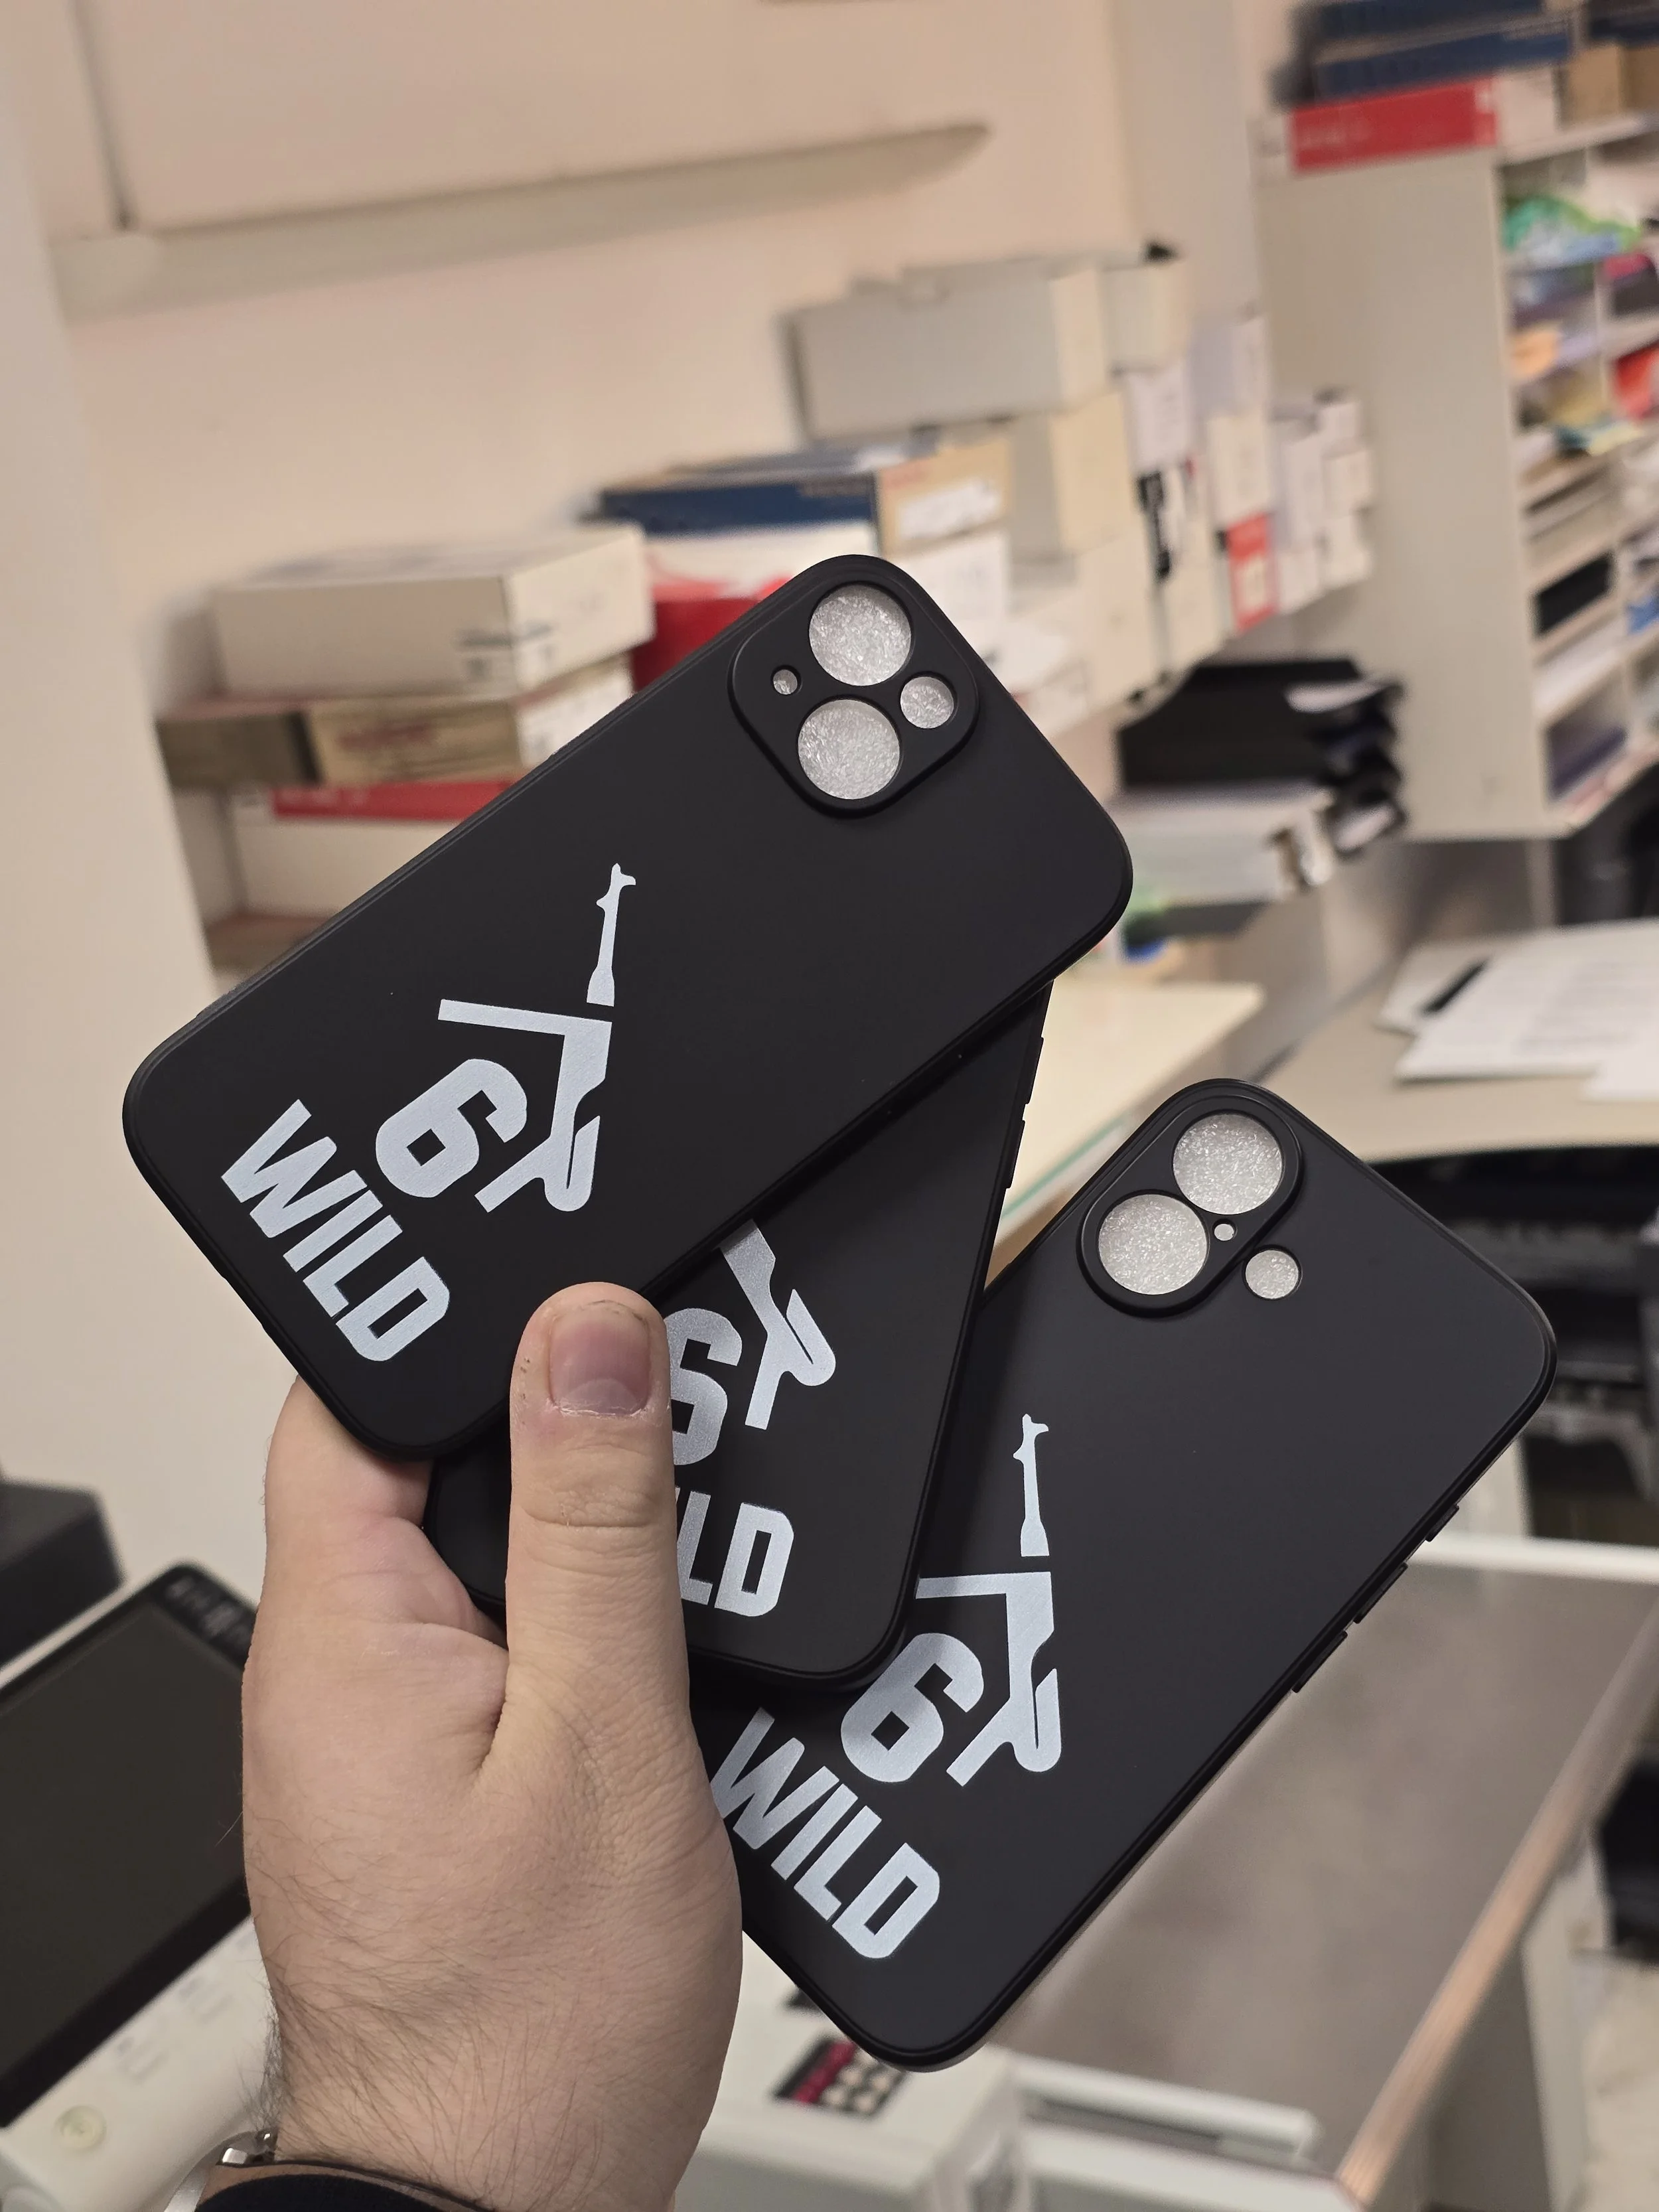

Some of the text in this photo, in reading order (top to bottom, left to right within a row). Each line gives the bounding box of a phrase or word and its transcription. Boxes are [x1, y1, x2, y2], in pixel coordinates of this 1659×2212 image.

[375, 1058, 528, 1199] 6
[221, 1098, 451, 1362] WILD
[840, 1633, 985, 1784] 6
[711, 1708, 940, 1960] WILD
